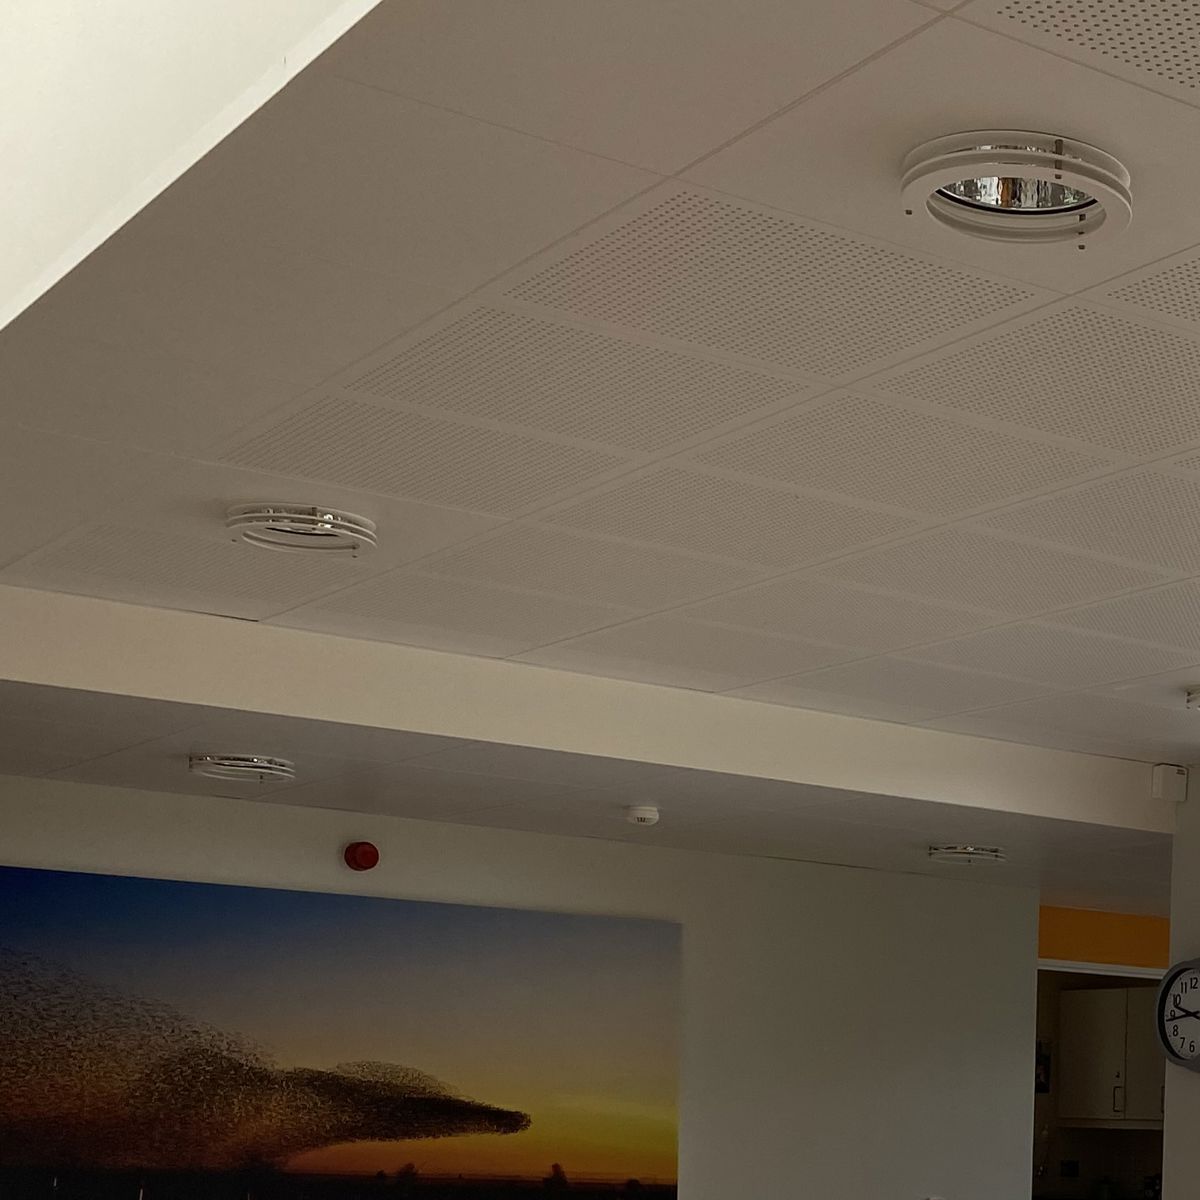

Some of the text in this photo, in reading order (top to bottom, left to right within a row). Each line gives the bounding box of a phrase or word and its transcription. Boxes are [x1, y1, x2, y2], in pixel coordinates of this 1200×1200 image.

[1181, 981, 1187, 994] 11
[1190, 977, 1198, 989] 12
[1173, 994, 1181, 1007] 10
[1170, 1009, 1176, 1019] 9
[1172, 1024, 1179, 1037] 8
[1180, 1037, 1185, 1048] 7
[1189, 1041, 1195, 1053] 6
